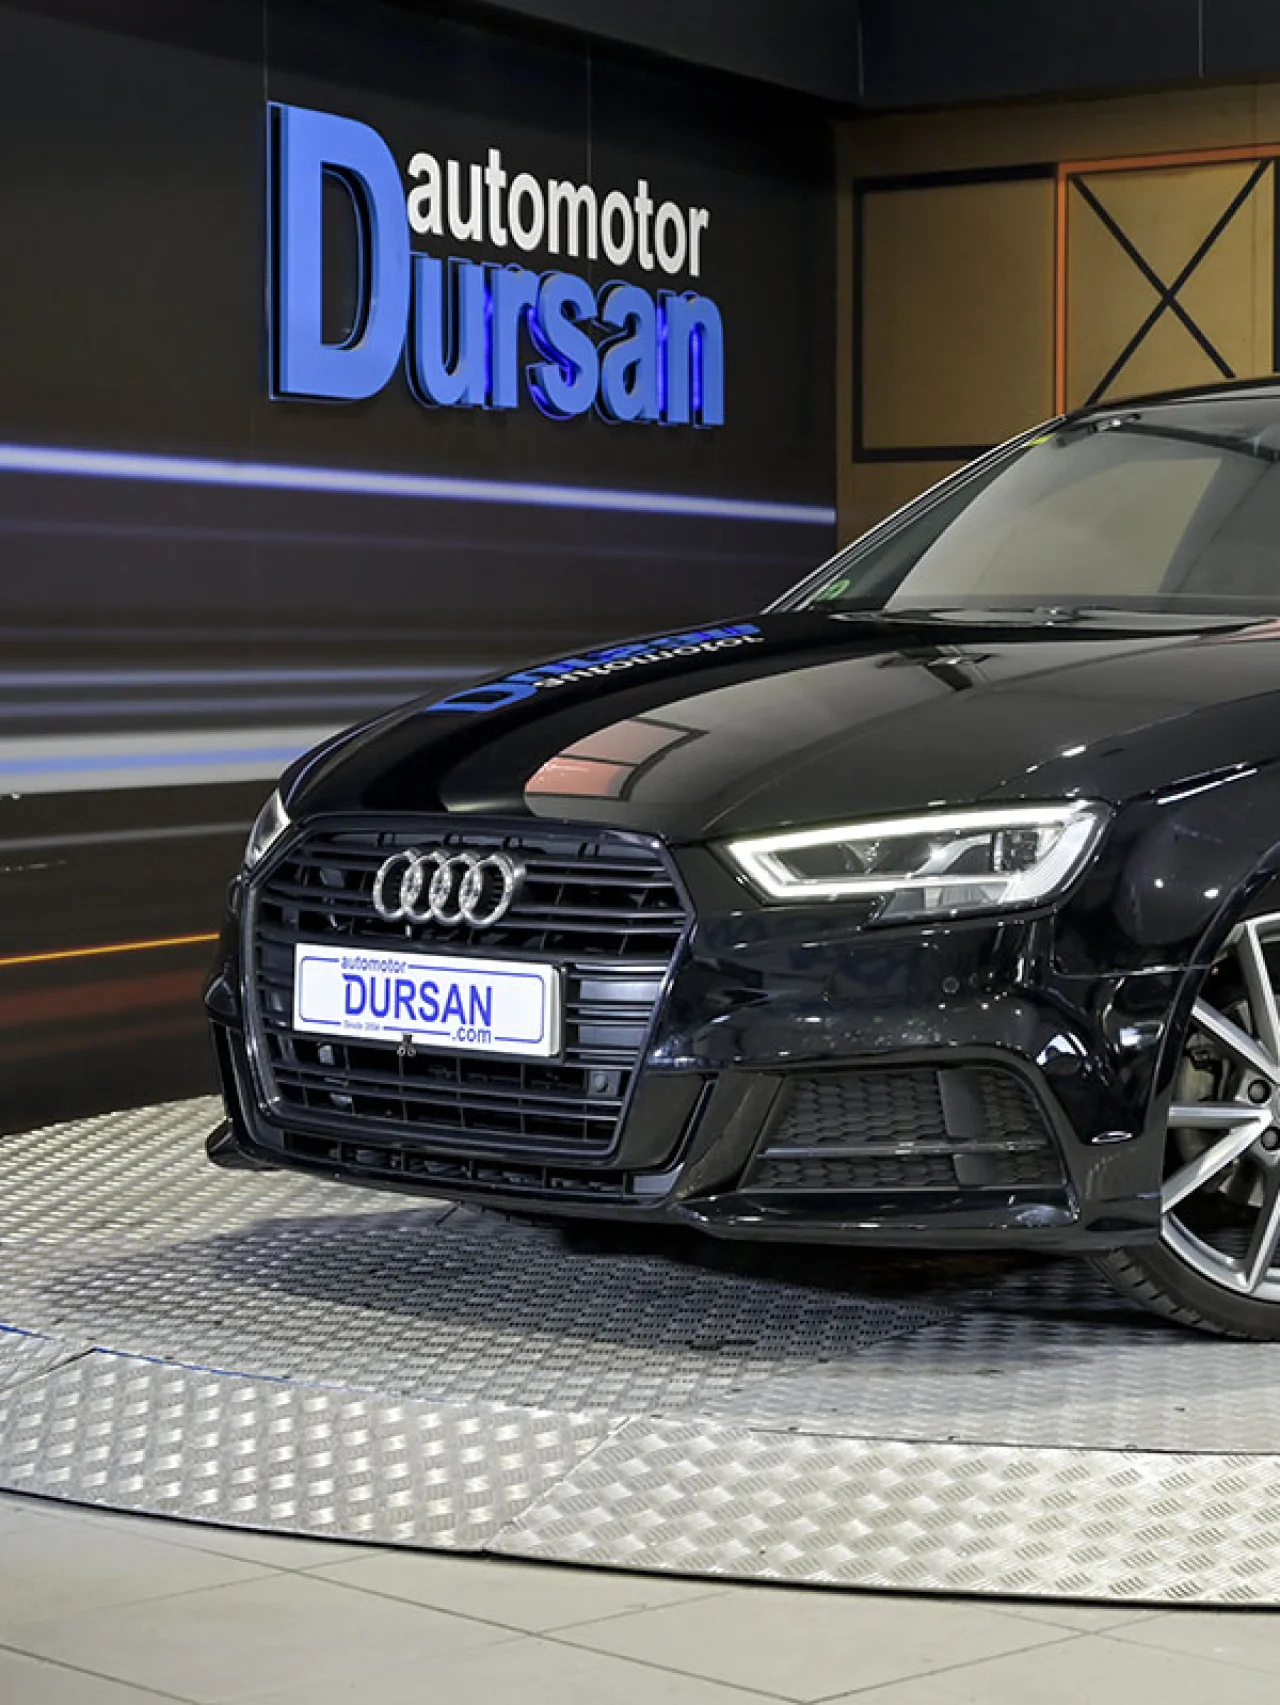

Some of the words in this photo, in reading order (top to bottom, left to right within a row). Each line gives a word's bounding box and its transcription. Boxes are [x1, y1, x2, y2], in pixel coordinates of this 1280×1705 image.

[406, 148, 709, 277] automotor
[267, 101, 724, 429] Dursan
[341, 956, 406, 973] automotor
[341, 973, 493, 1027] DURSAN
[451, 1026, 492, 1044] .com
